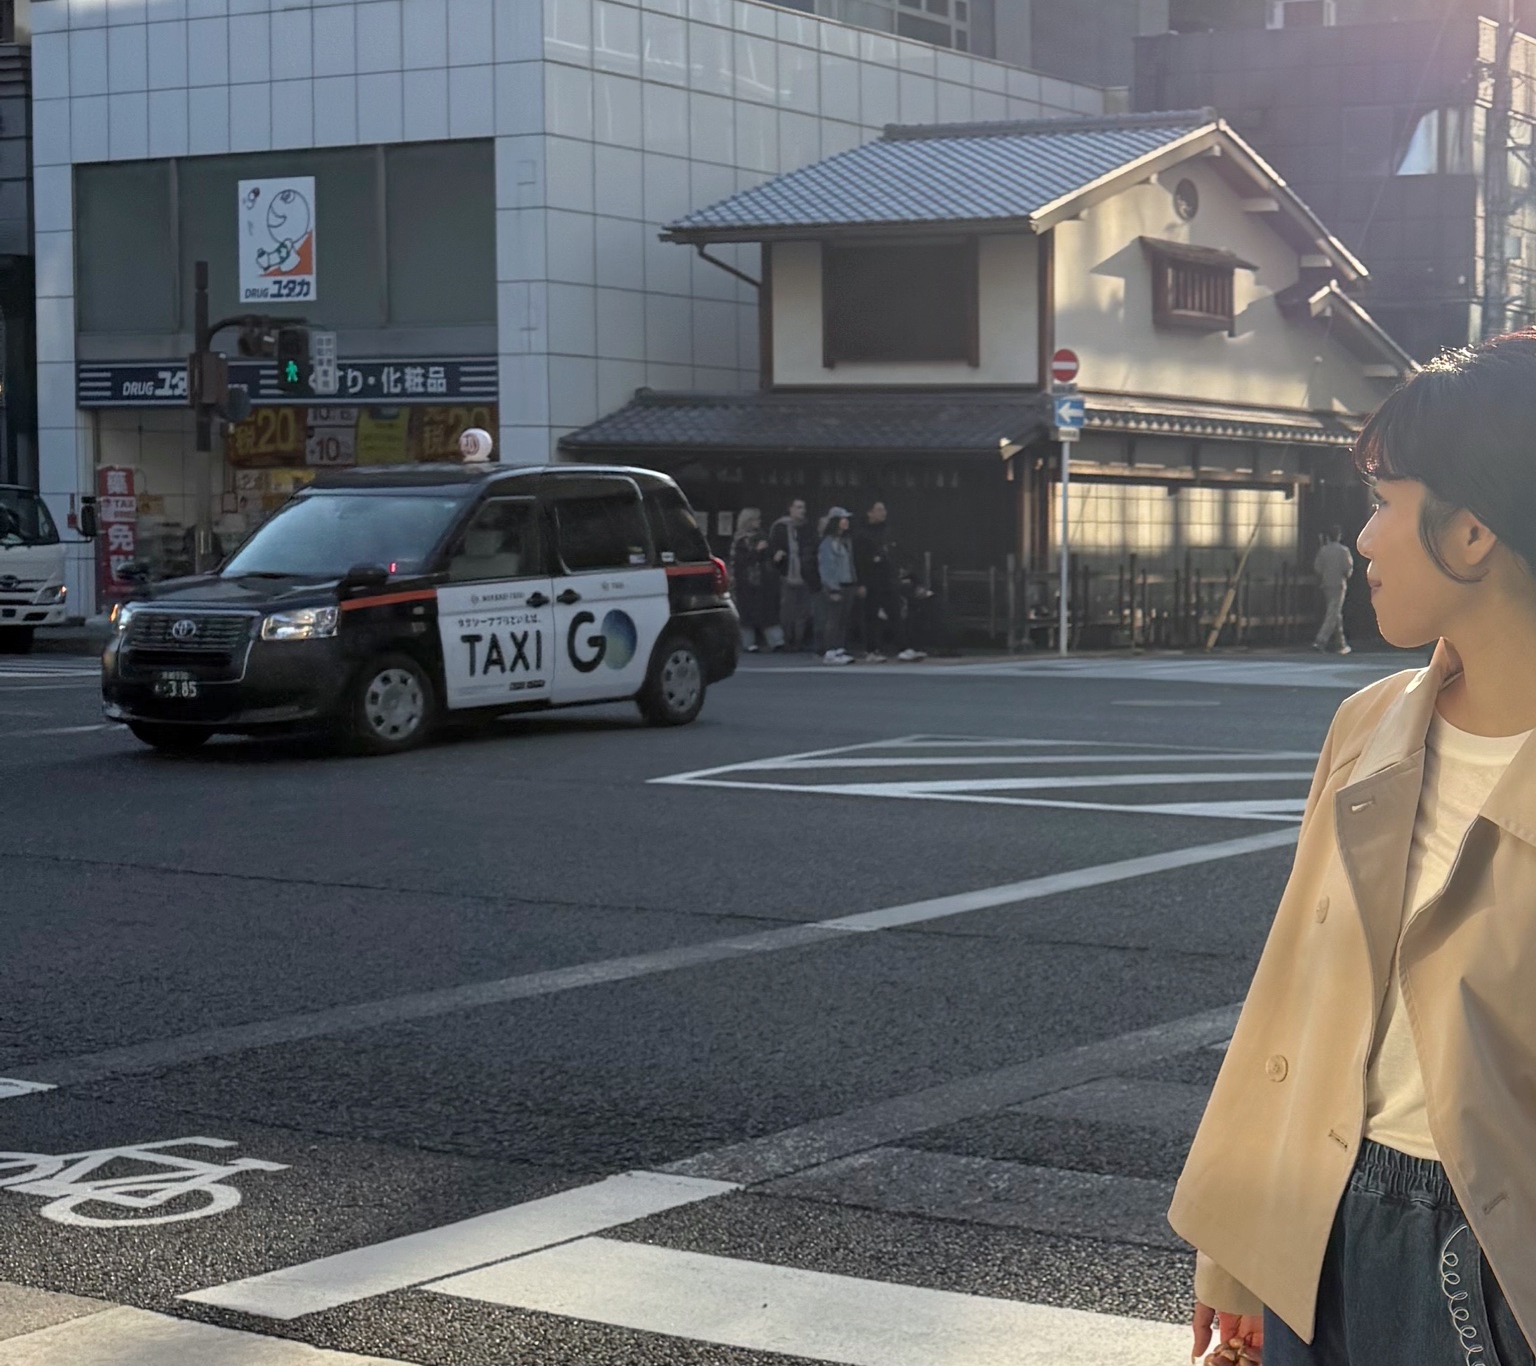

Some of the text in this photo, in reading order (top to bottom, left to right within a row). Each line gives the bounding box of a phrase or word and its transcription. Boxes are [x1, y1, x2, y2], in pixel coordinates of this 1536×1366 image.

[245, 278, 311, 299] DRUG ユタカ
[122, 381, 154, 396] DRUG
[257, 407, 297, 453] 20
[461, 629, 543, 677] TAXI
